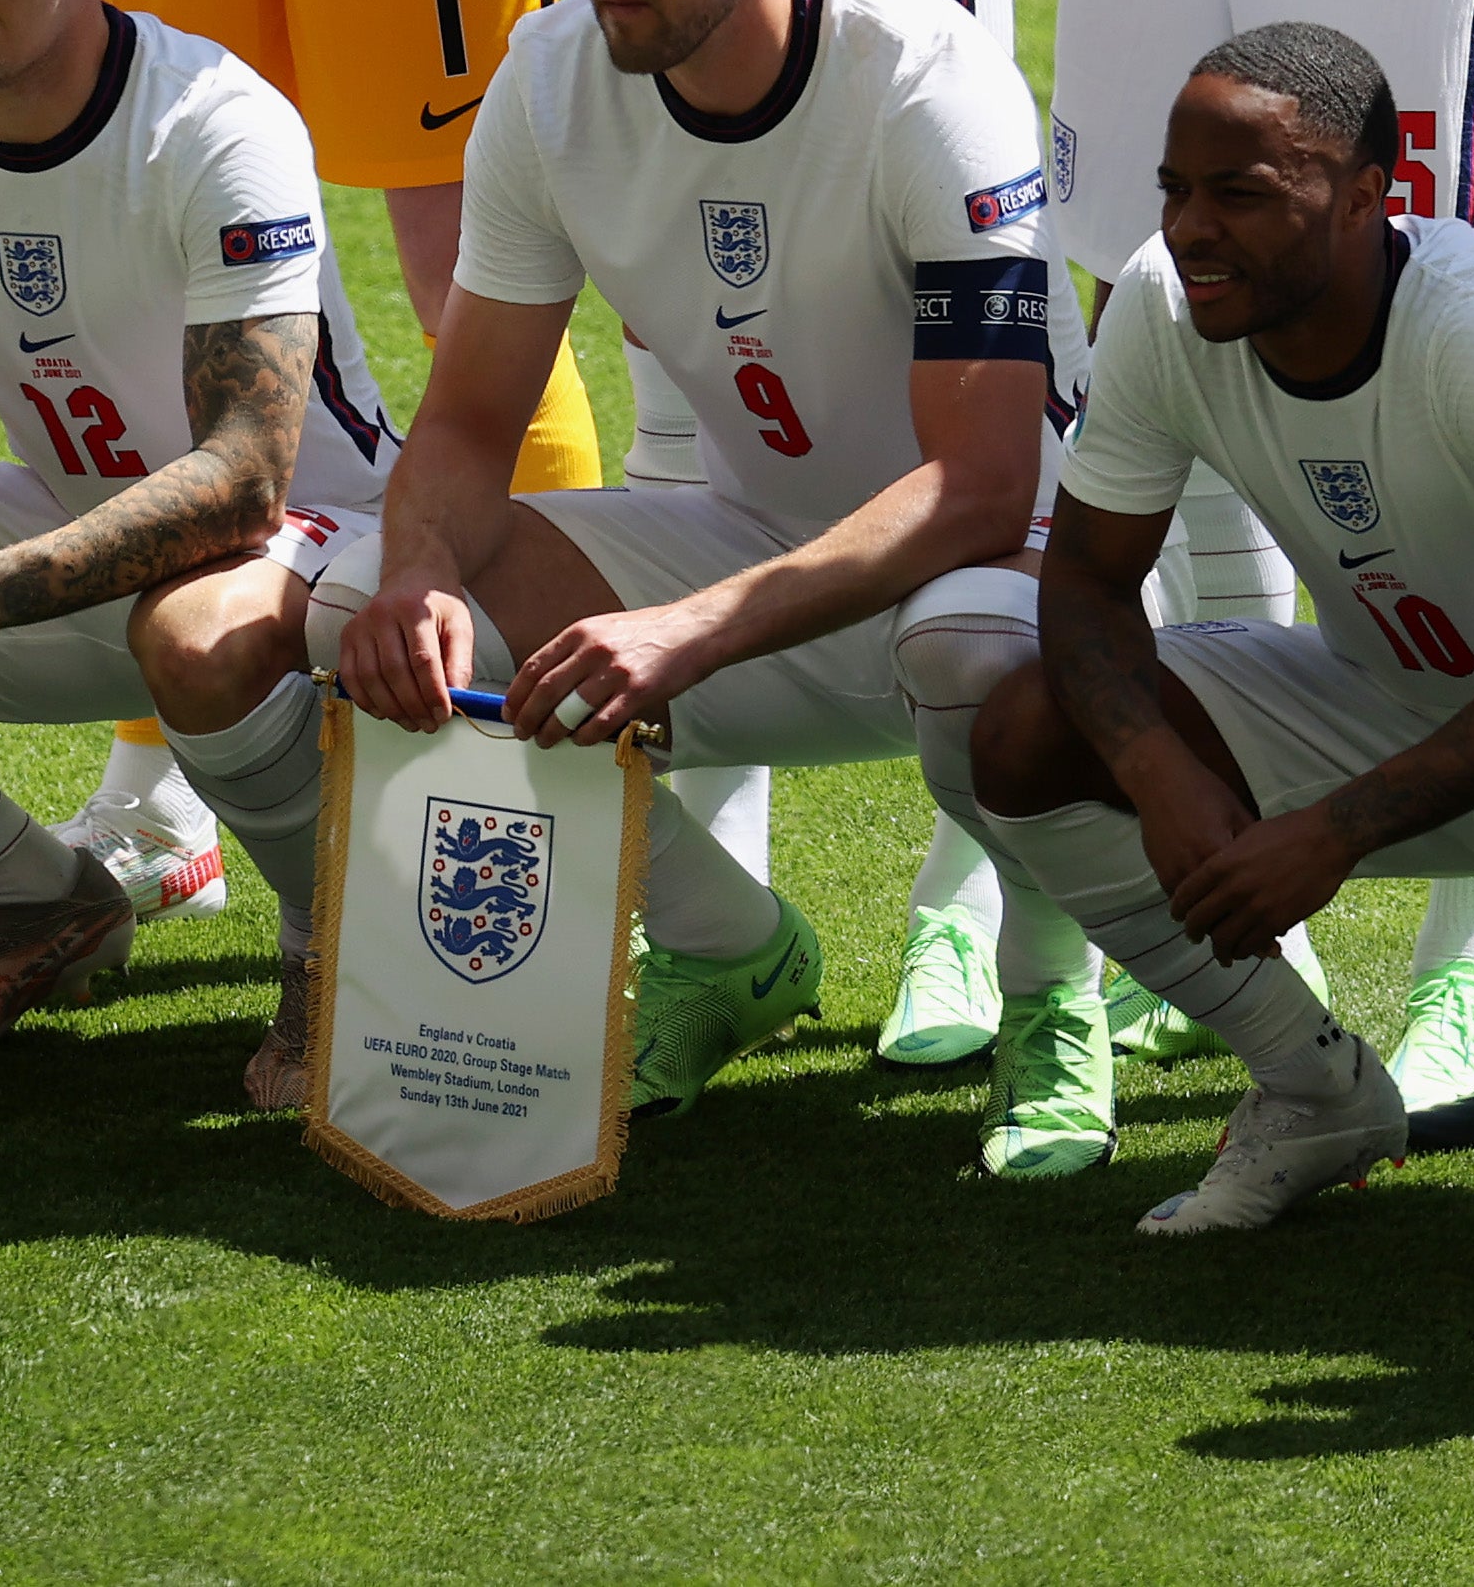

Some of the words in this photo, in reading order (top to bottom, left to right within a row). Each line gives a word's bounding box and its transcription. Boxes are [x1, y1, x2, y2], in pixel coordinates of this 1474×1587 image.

[999, 176, 1045, 214] RESPECT
[257, 223, 314, 251] RESPECT
[35, 358, 73, 368] CROATIA
[734, 362, 813, 458] 9
[19, 382, 150, 478] 12
[420, 1024, 464, 1044] England
[466, 1033, 474, 1044] v
[476, 1033, 516, 1051] Croatia
[364, 1036, 393, 1054] UEFA
[395, 1042, 428, 1059] EURO
[430, 1048, 460, 1066] 2020,
[463, 1053, 497, 1071] Group
[500, 1058, 533, 1078] Stage
[536, 1064, 571, 1081] Match
[390, 1063, 441, 1085] Wembley
[444, 1072, 495, 1093] Stadium,
[497, 1079, 540, 1098] London
[400, 1086, 441, 1107] Sunday
[444, 1094, 469, 1110] 13th
[471, 1097, 499, 1114] June
[502, 1102, 528, 1118] 2021
